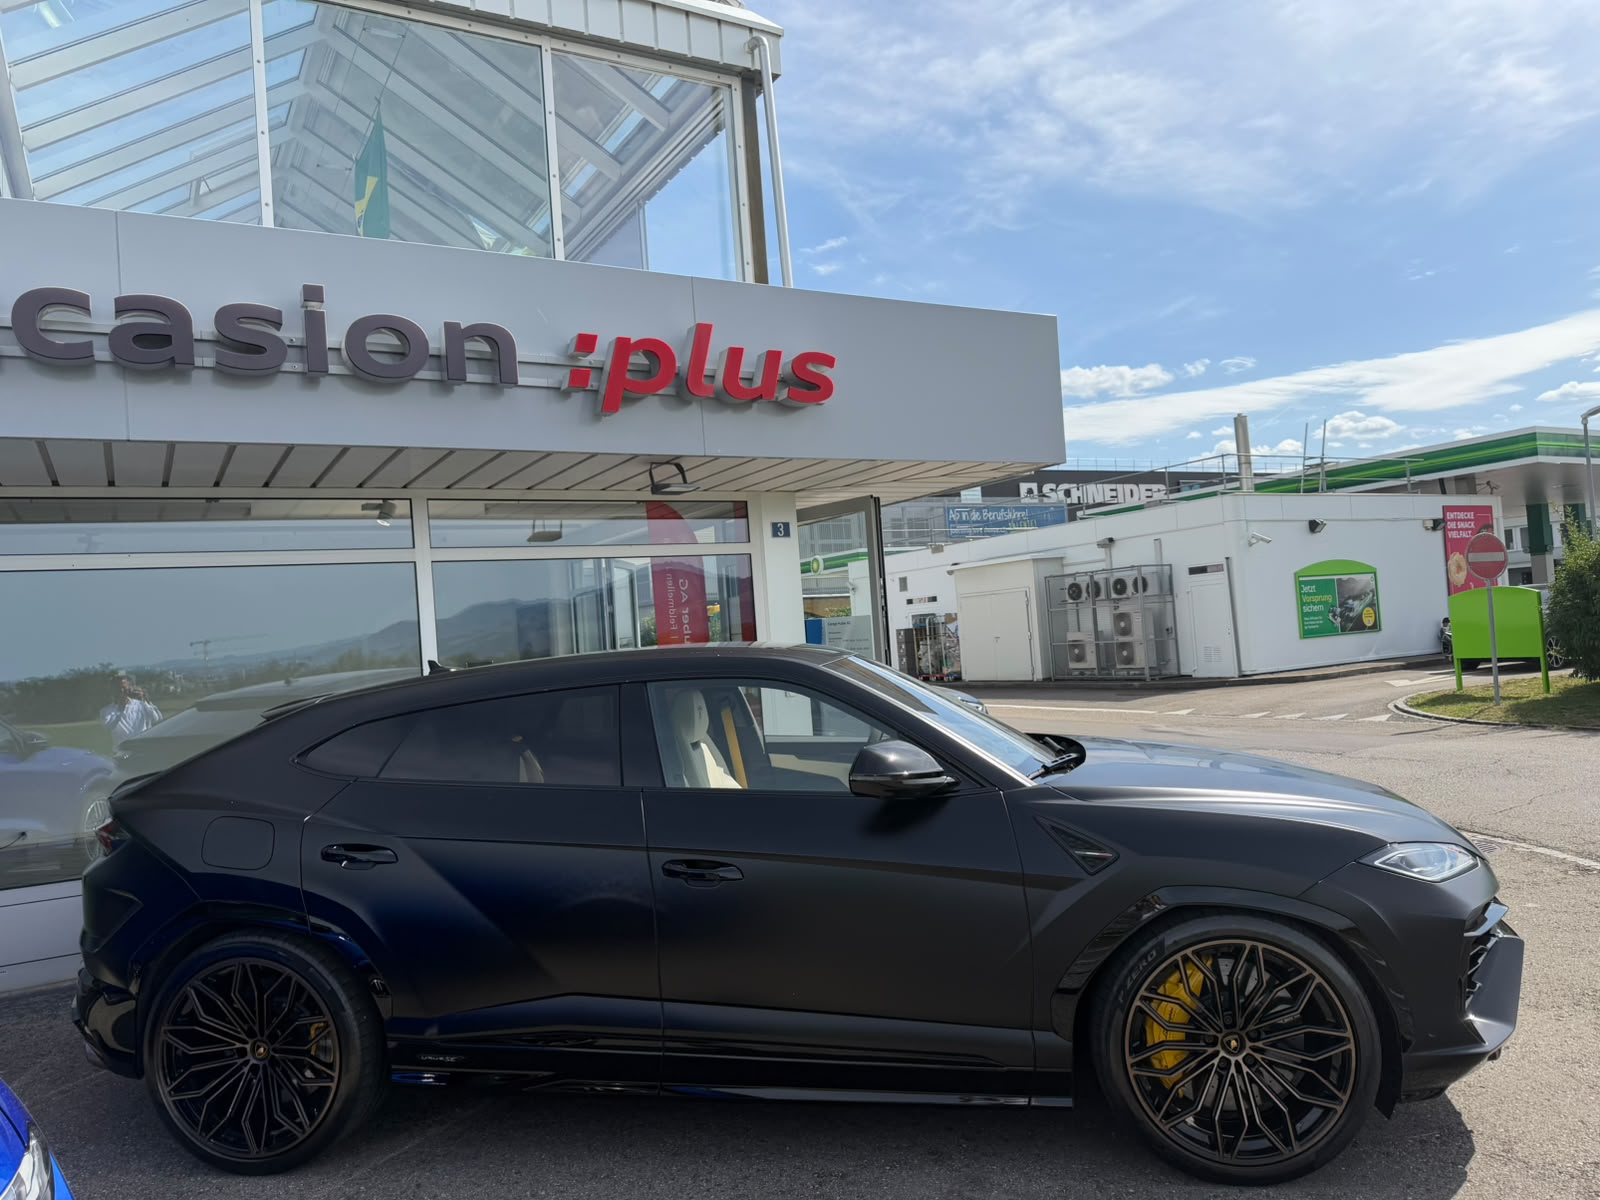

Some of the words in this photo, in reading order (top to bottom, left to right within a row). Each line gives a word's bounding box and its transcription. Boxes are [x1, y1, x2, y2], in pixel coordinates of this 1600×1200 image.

[1041, 482, 1168, 504] SCHNEIDER
[1446, 511, 1475, 520] ENTDECKE
[1447, 521, 1457, 529] DIE
[1457, 521, 1476, 529] SNACK
[777, 523, 784, 537] 3
[1301, 584, 1316, 593] Jetzt
[1303, 603, 1325, 613] sichern
